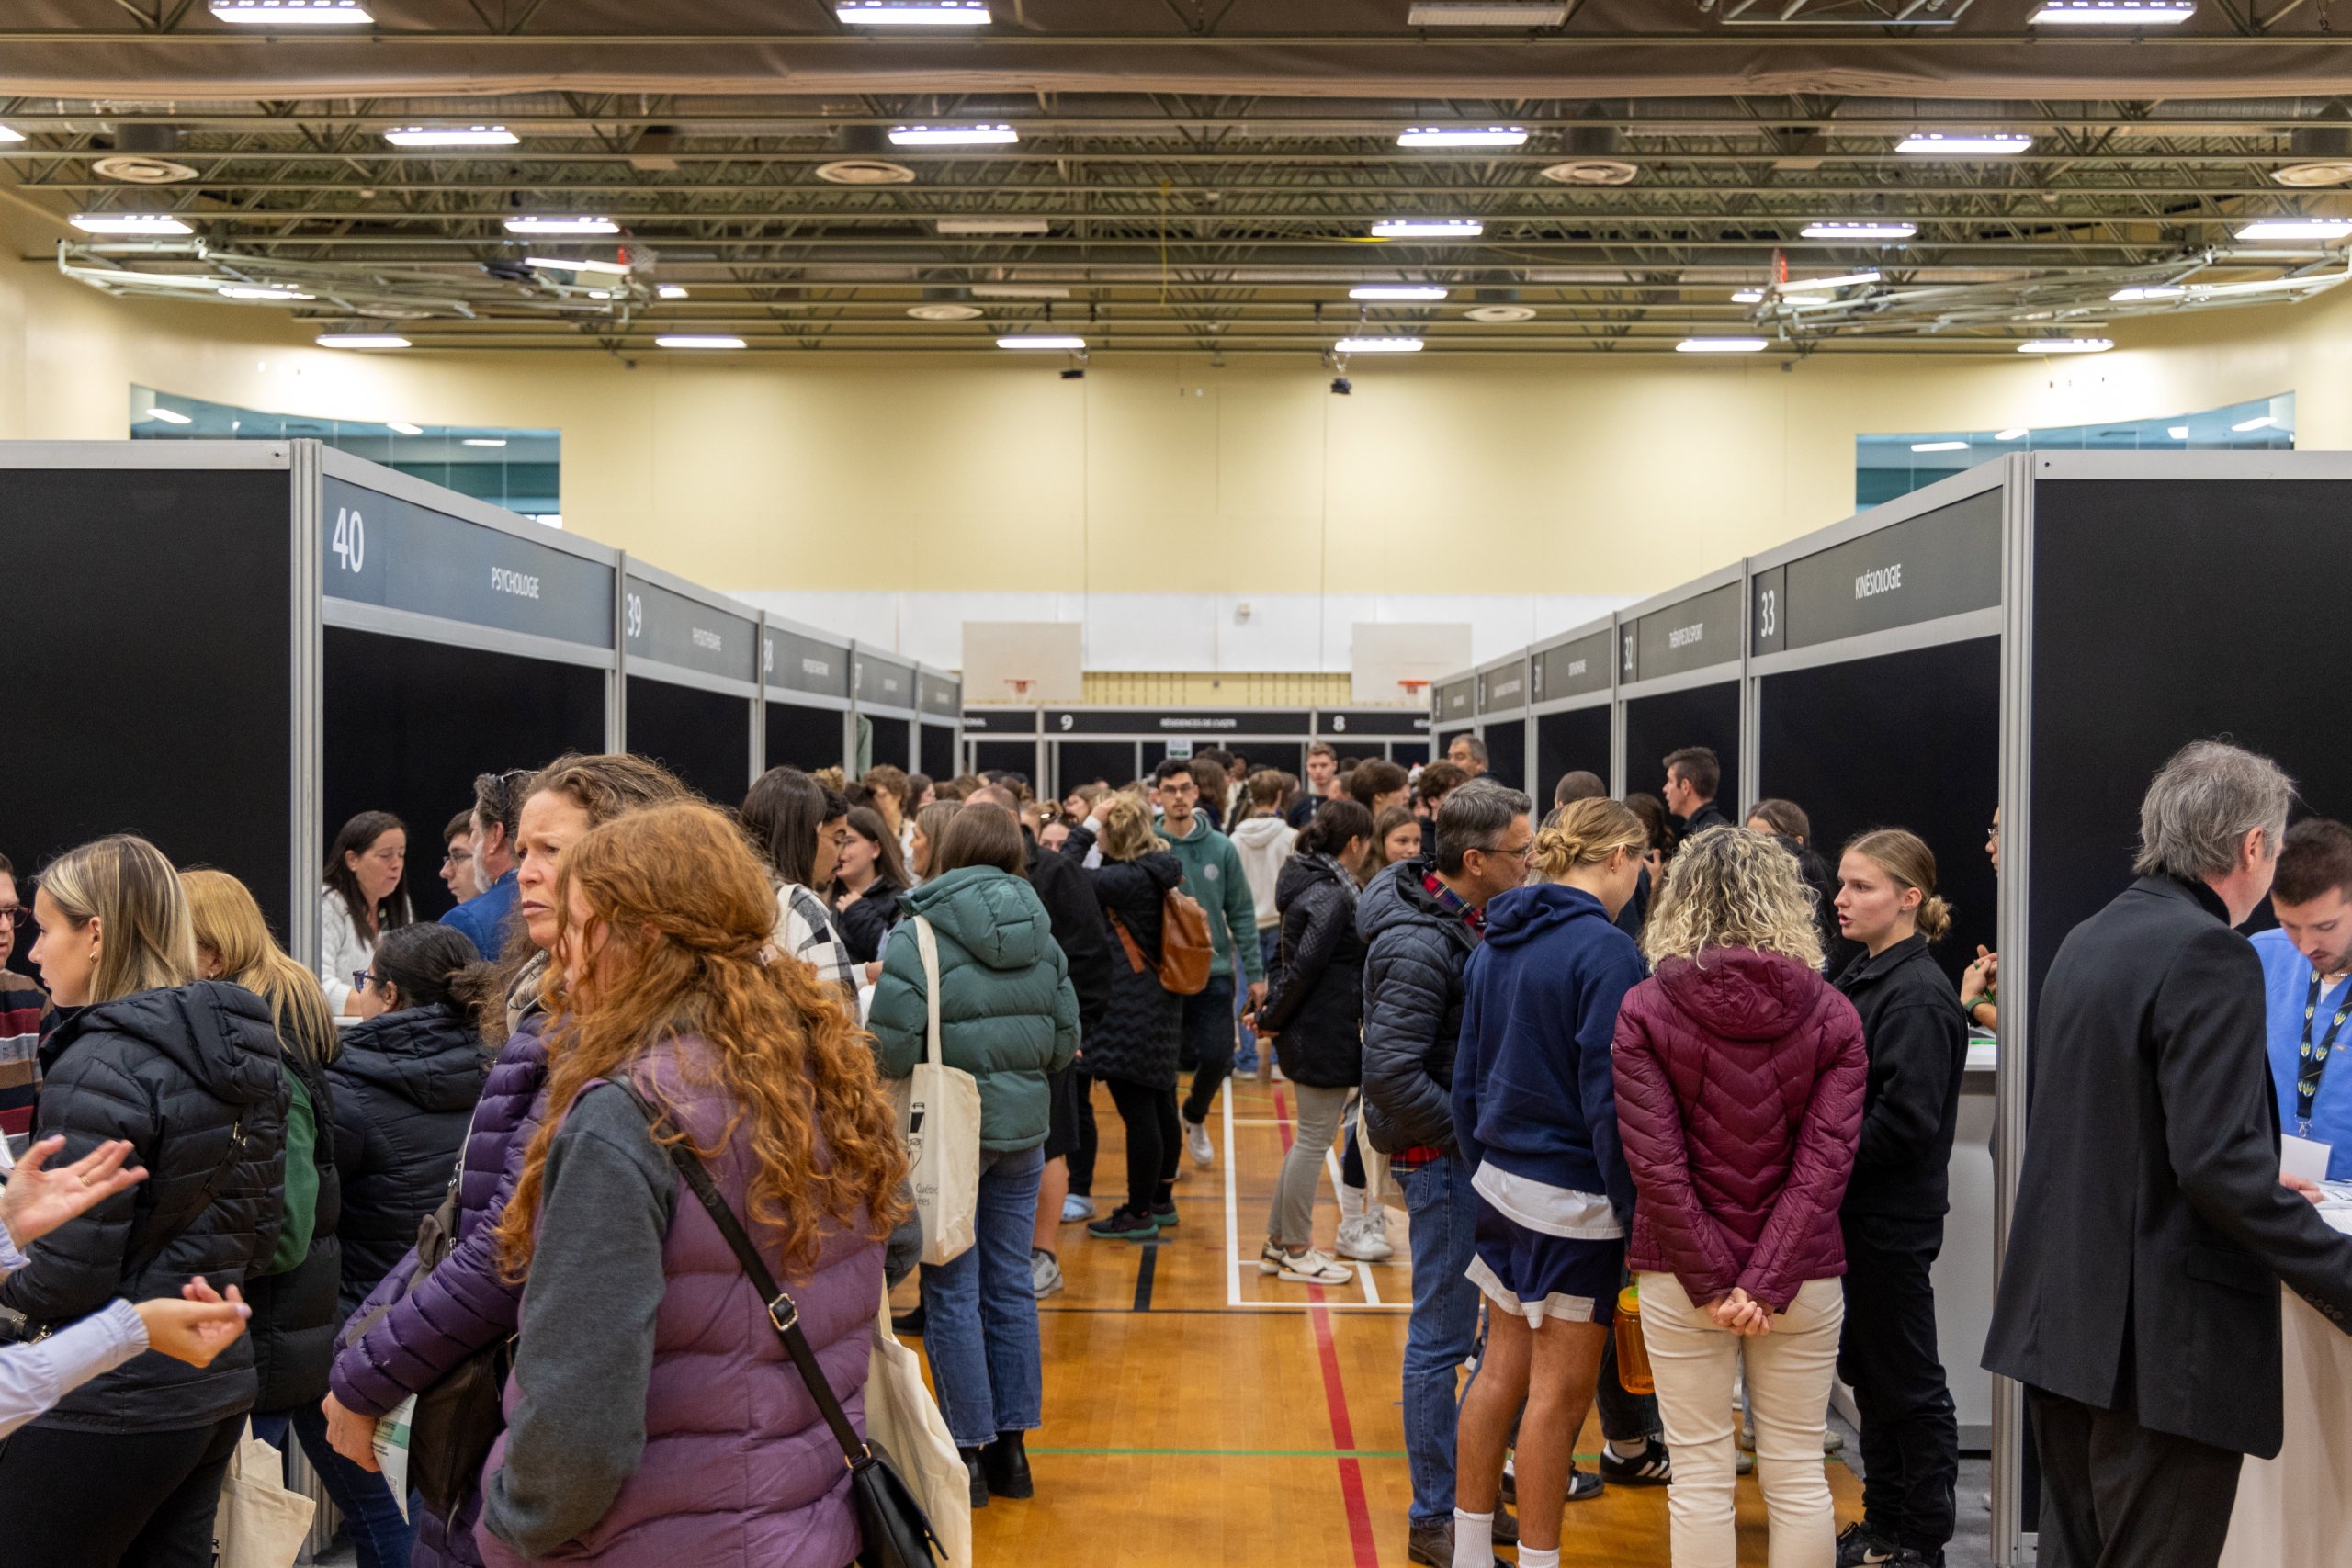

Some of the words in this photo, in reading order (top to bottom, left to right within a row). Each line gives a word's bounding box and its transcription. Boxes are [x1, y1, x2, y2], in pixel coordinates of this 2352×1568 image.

[332, 507, 365, 573] 40
[492, 566, 539, 599] PSYCHOLOGIE
[1855, 563, 1901, 600] KINÉSIOLOGIE
[627, 592, 641, 637] 39
[1761, 590, 1775, 637] 33
[1060, 714, 1074, 731] 9
[1333, 715, 1346, 732] 8
